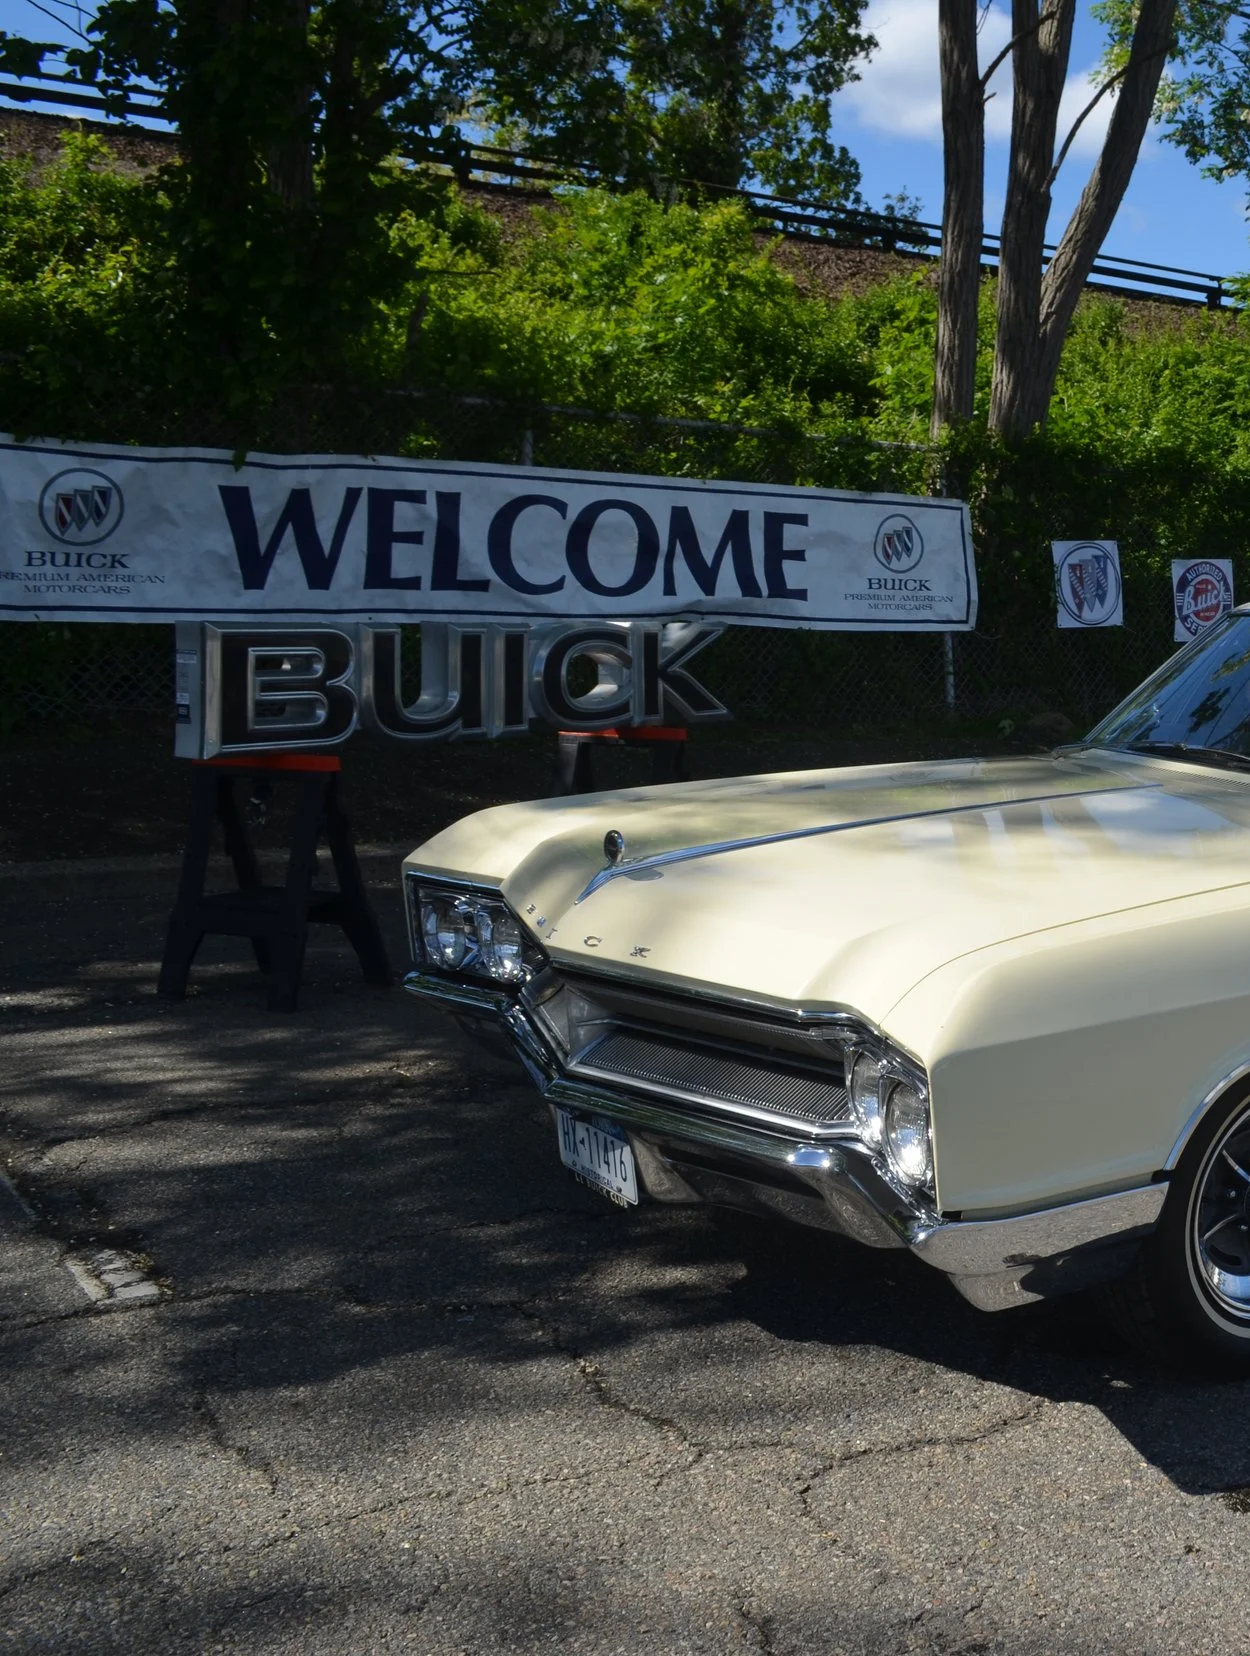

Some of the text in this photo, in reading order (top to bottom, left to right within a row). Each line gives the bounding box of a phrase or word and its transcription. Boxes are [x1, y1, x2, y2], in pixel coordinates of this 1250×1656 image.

[218, 484, 808, 602] WELCOME
[24, 551, 130, 569] BUICK
[0, 571, 165, 584] REMIUM AMERICAN
[1186, 564, 1223, 582] AUTHORIZED
[23, 584, 131, 594] MOTORCARS
[866, 577, 932, 592] BUICK
[844, 593, 954, 603] PREMIUM AMERICAN
[867, 602, 933, 611] MOTORCARS
[205, 622, 730, 757] BUICK
